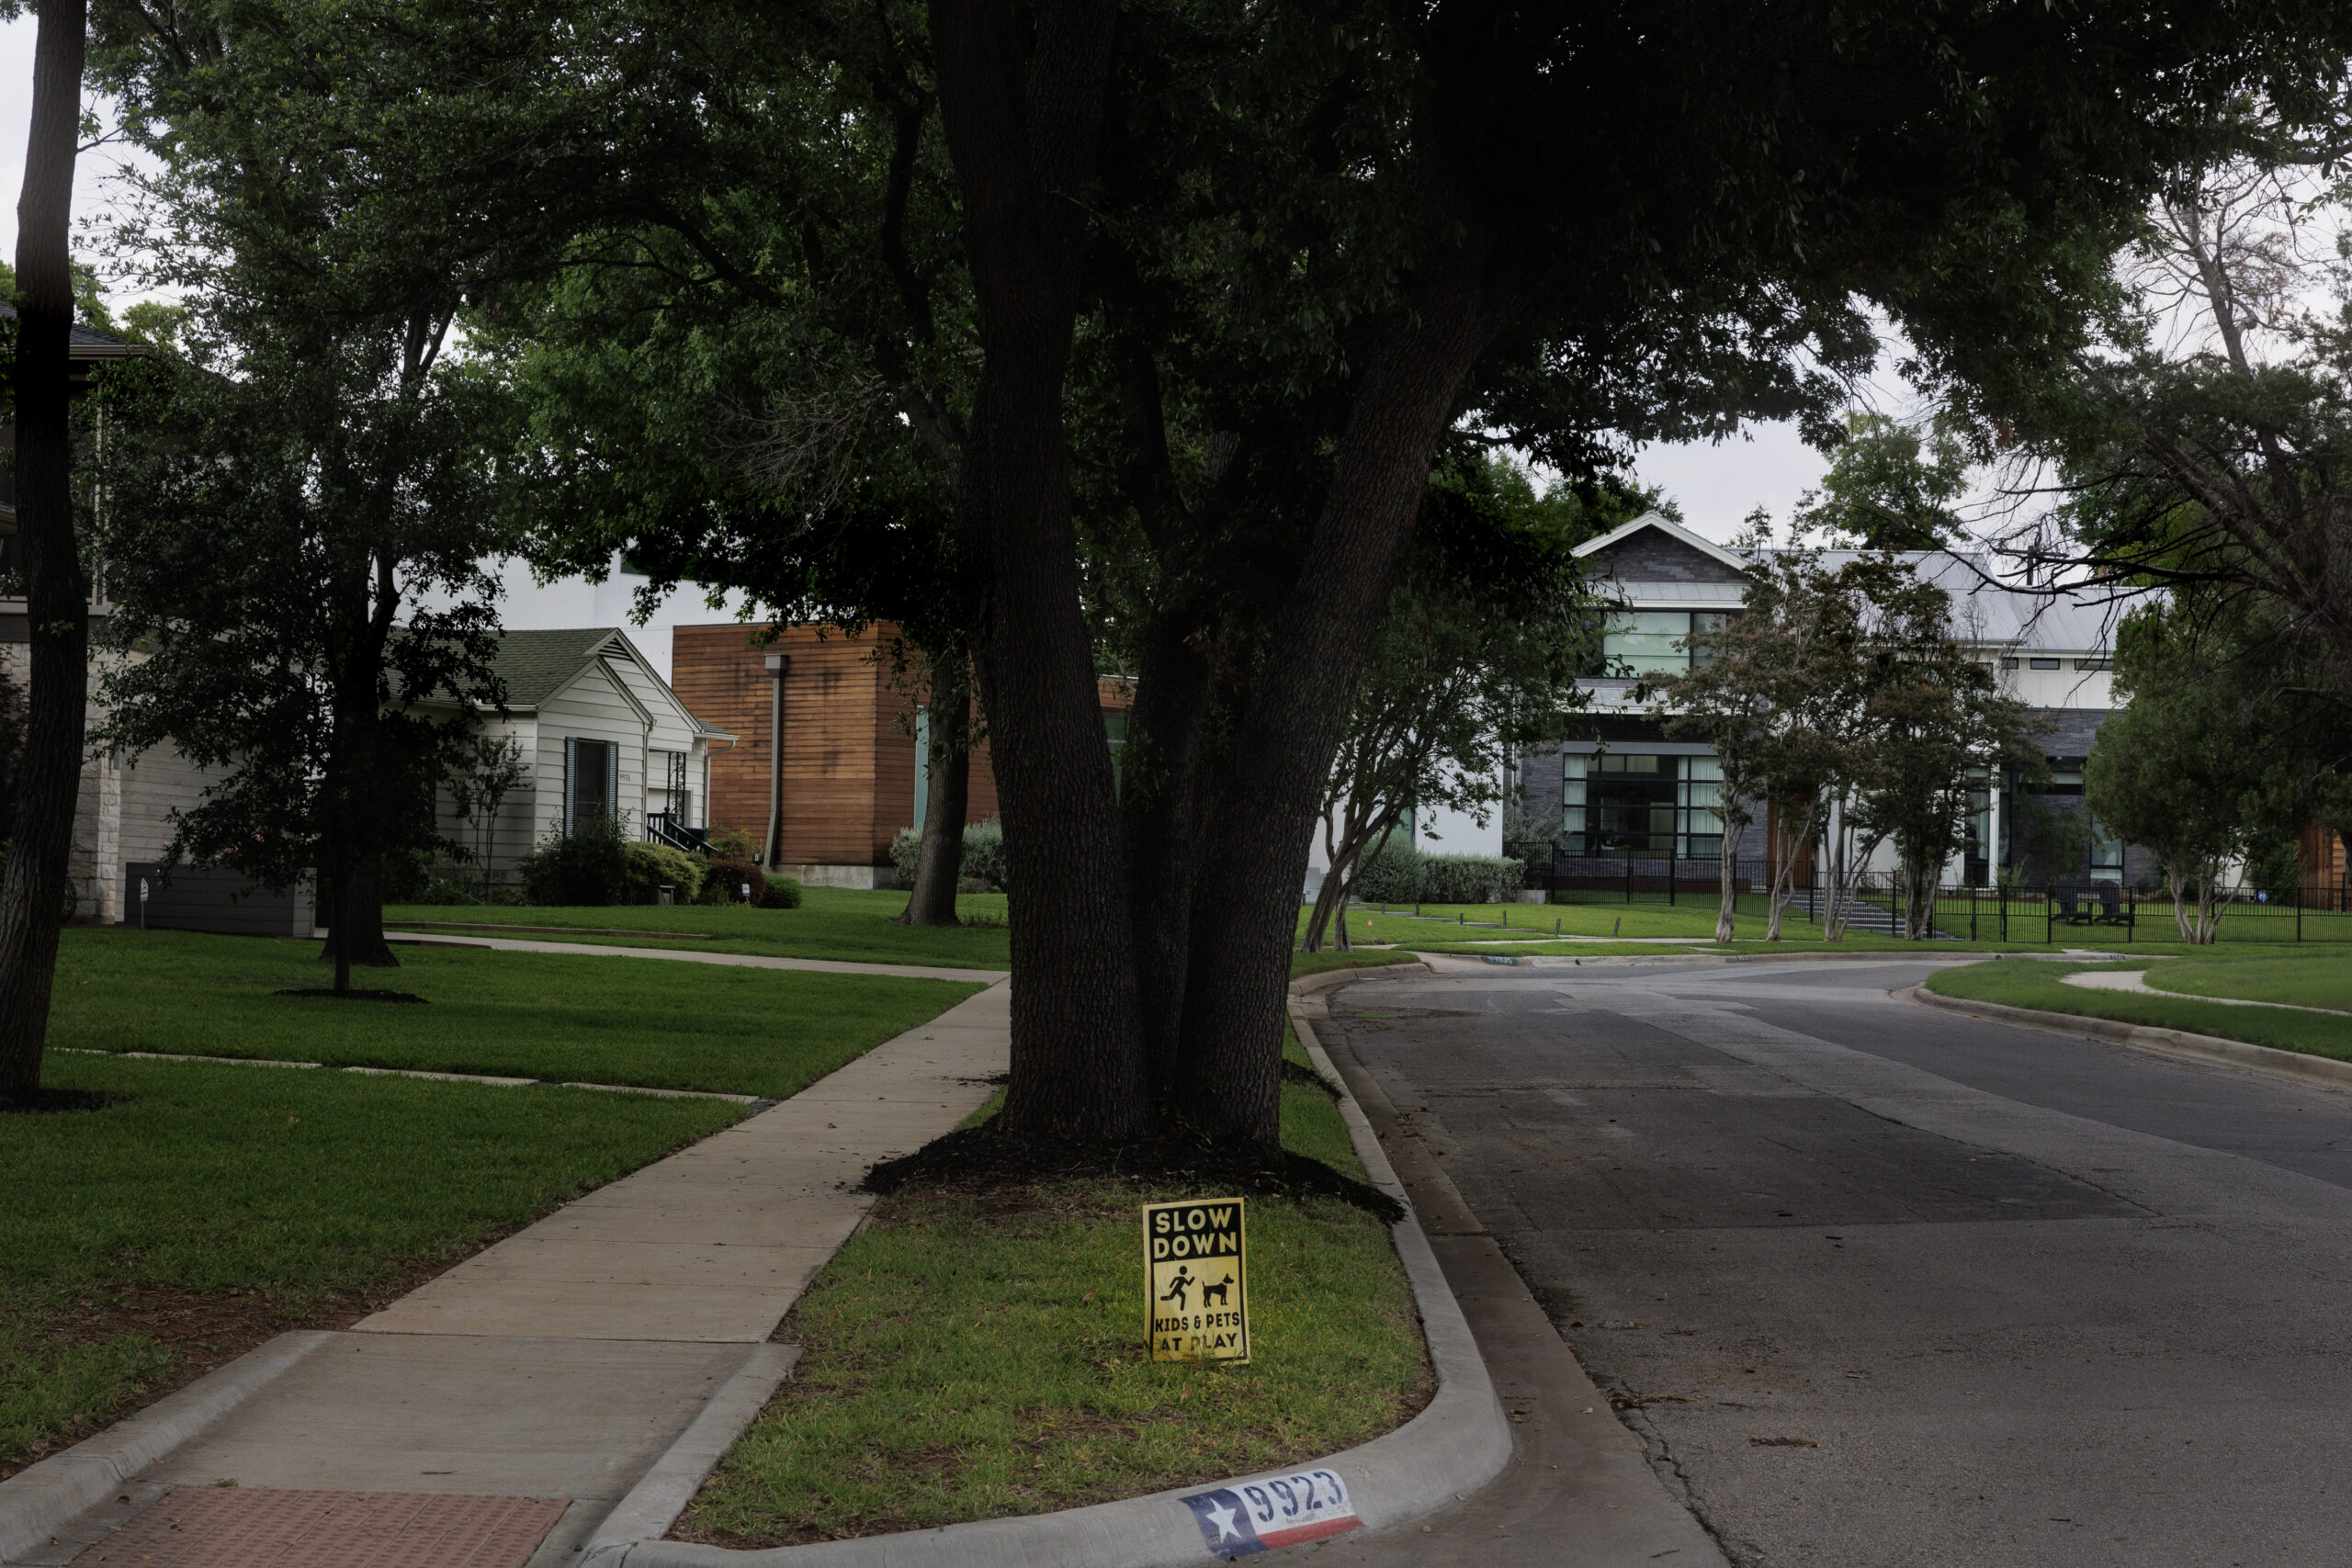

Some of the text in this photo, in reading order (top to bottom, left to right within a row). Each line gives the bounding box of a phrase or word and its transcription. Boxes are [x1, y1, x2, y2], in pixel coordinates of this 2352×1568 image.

[1155, 1206, 1233, 1234] SLOW
[1153, 1231, 1237, 1259] DOWN
[1155, 1312, 1240, 1332] KIDS & PETS
[1161, 1333, 1237, 1351] AT PLAY
[1243, 1471, 1343, 1522] 9923
